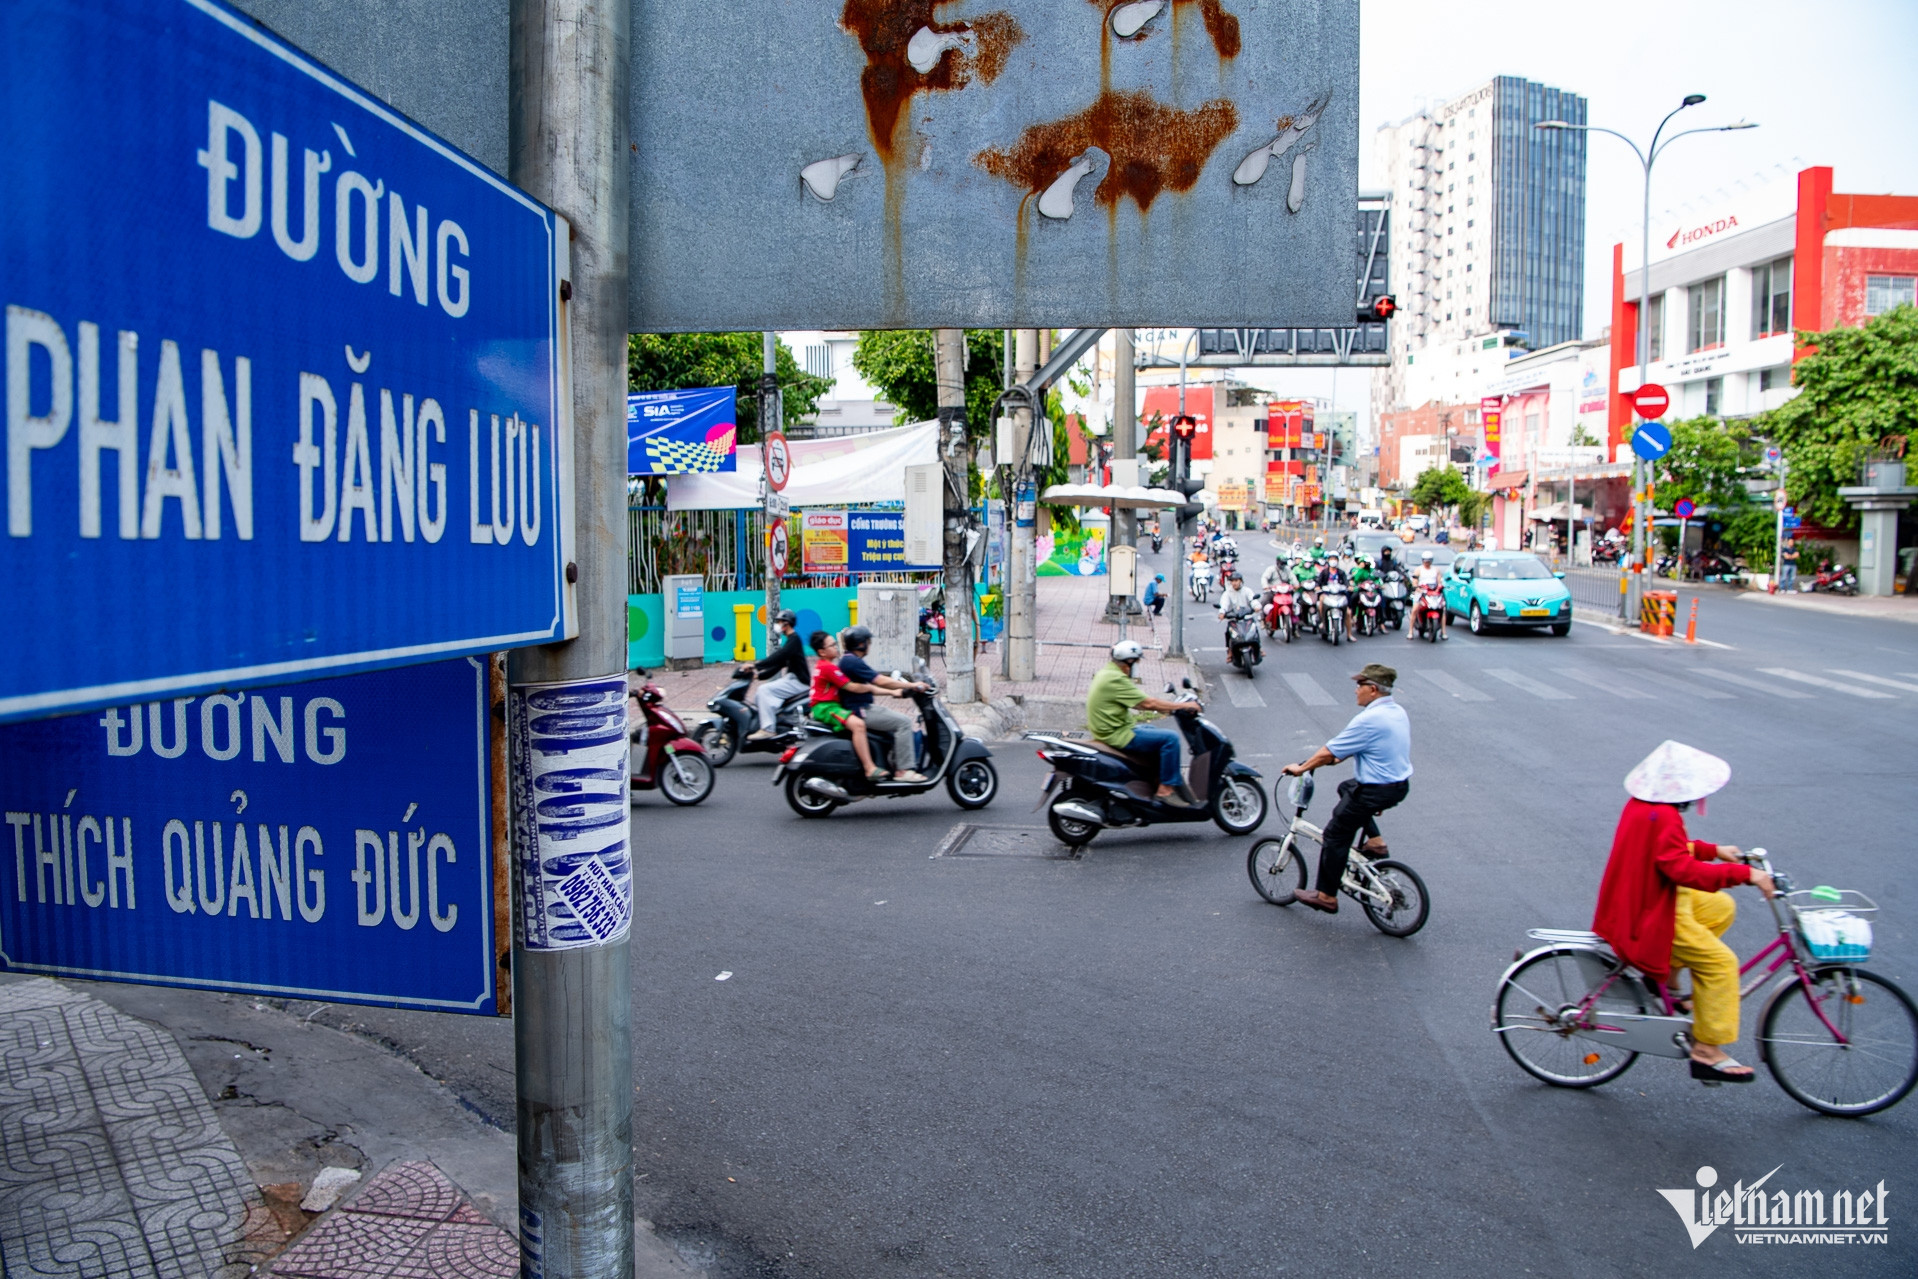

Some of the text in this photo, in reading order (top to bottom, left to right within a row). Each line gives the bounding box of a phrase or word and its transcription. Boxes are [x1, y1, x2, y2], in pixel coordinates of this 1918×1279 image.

[197, 99, 470, 318] ĐƯỜNG
[1682, 215, 1739, 245] HONDA
[6, 304, 541, 547] PHAN ĐĂNG LƯU
[5, 788, 136, 910] THÍCH
[162, 789, 326, 924] QUẢNG
[352, 803, 458, 933] ĐỨC
[560, 874, 617, 940] 0982.756.333
[587, 860, 605, 879] HÚT
